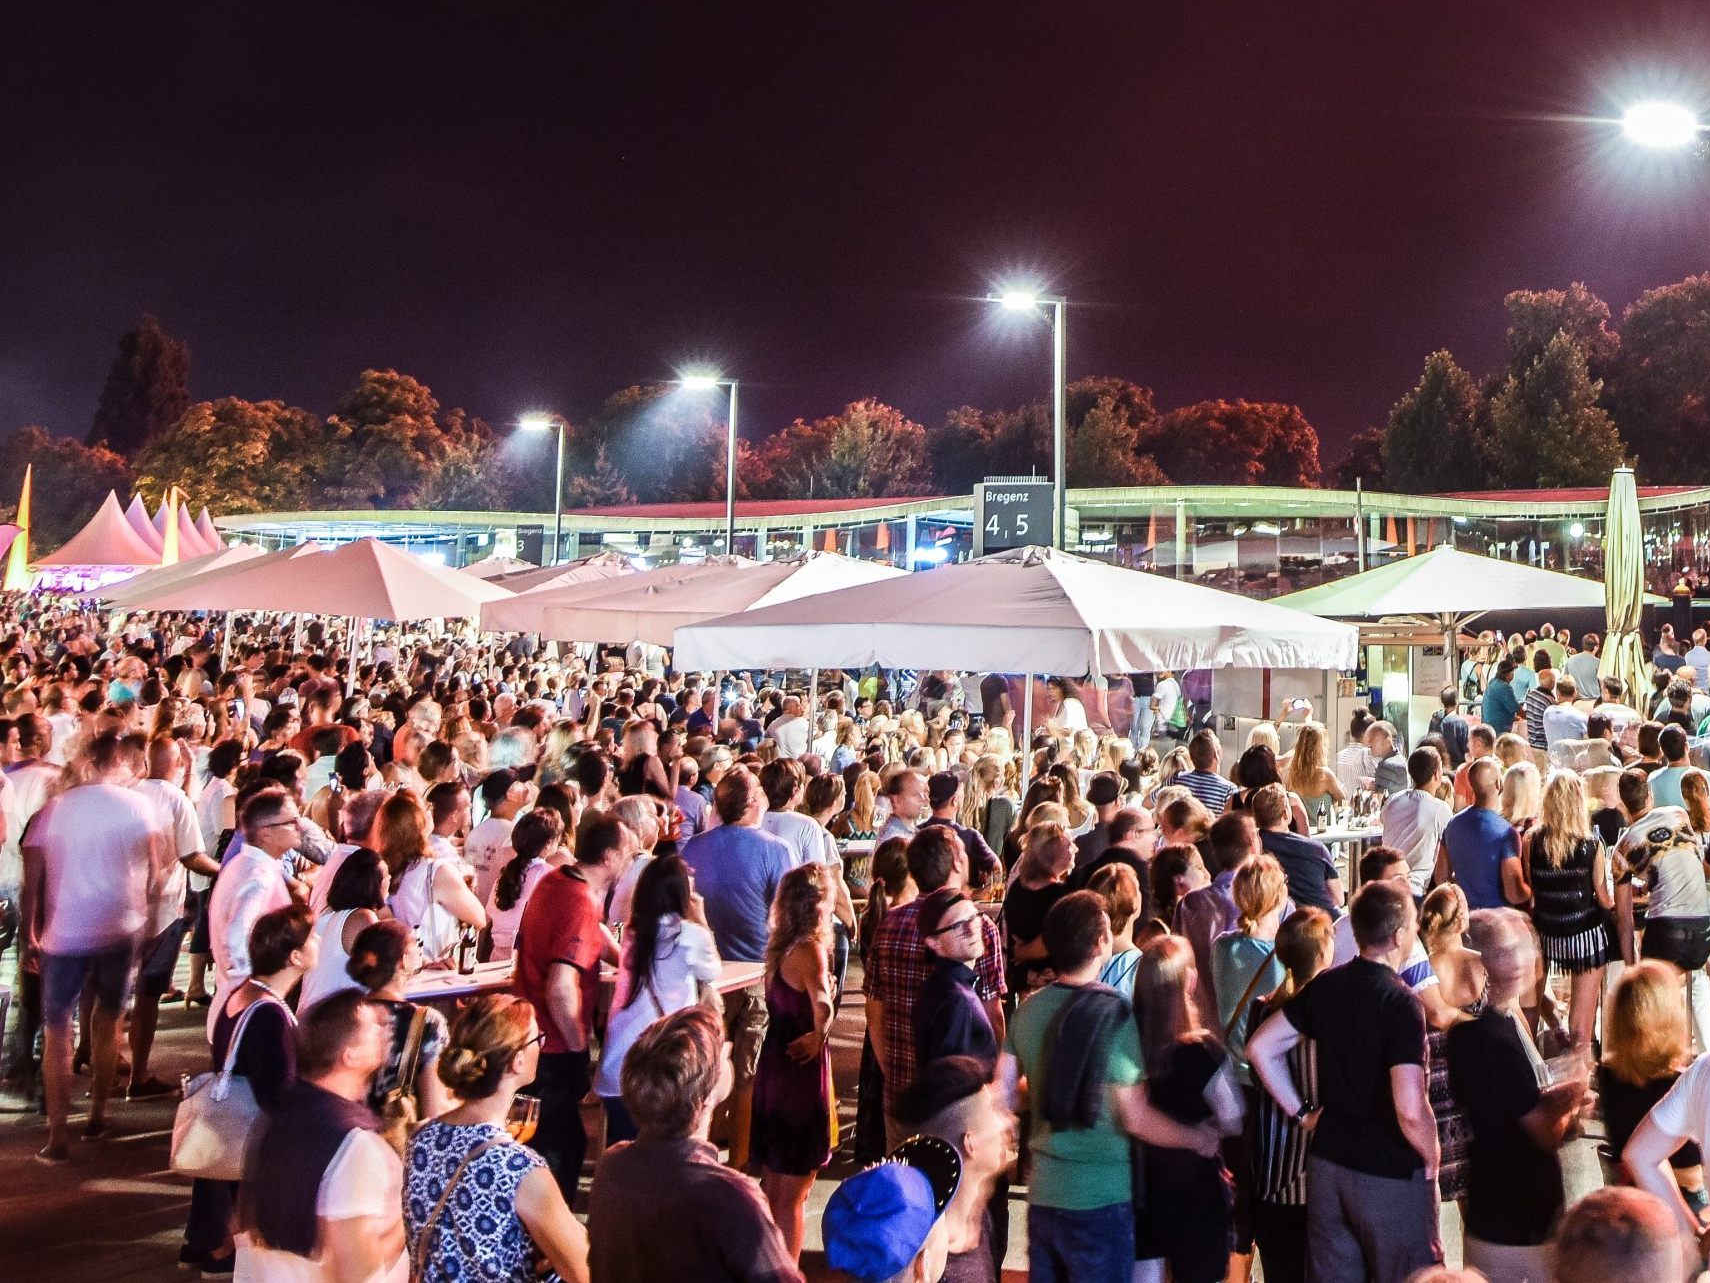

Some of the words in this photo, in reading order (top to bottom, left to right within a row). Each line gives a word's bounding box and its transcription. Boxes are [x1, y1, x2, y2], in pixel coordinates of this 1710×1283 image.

[985, 491, 1029, 504] Bregenz
[1016, 514, 1029, 535] 5
[518, 528, 542, 536] Bregenz
[517, 539, 525, 552] 3
